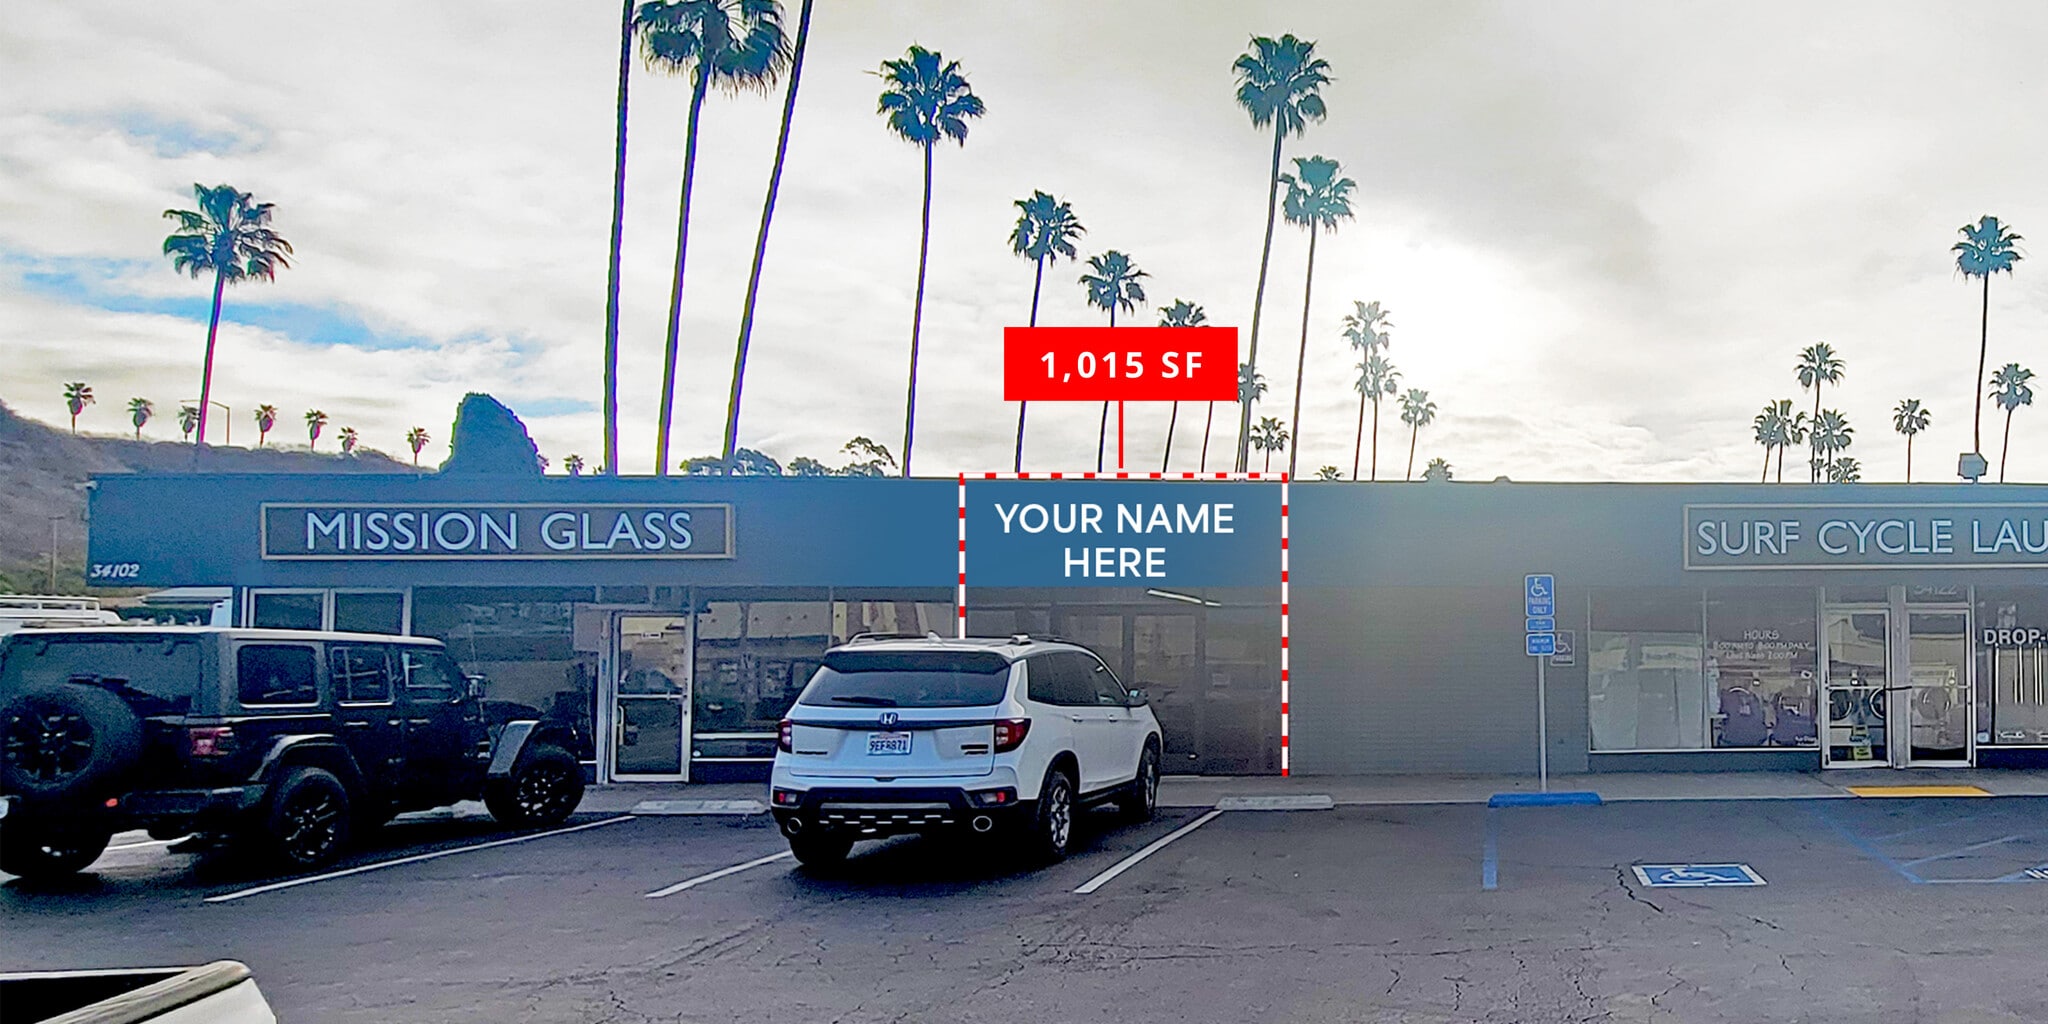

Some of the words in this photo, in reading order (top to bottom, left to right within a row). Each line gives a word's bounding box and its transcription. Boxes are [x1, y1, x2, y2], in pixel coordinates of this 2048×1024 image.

[306, 511, 518, 550] MISSION
[541, 511, 693, 550] GLASS
[1696, 520, 1800, 555] SURF
[1817, 520, 1954, 555] CYCLE
[90, 563, 140, 578] 34102
[1743, 629, 1780, 641] HOURS
[1983, 628, 2048, 645] DROP-
